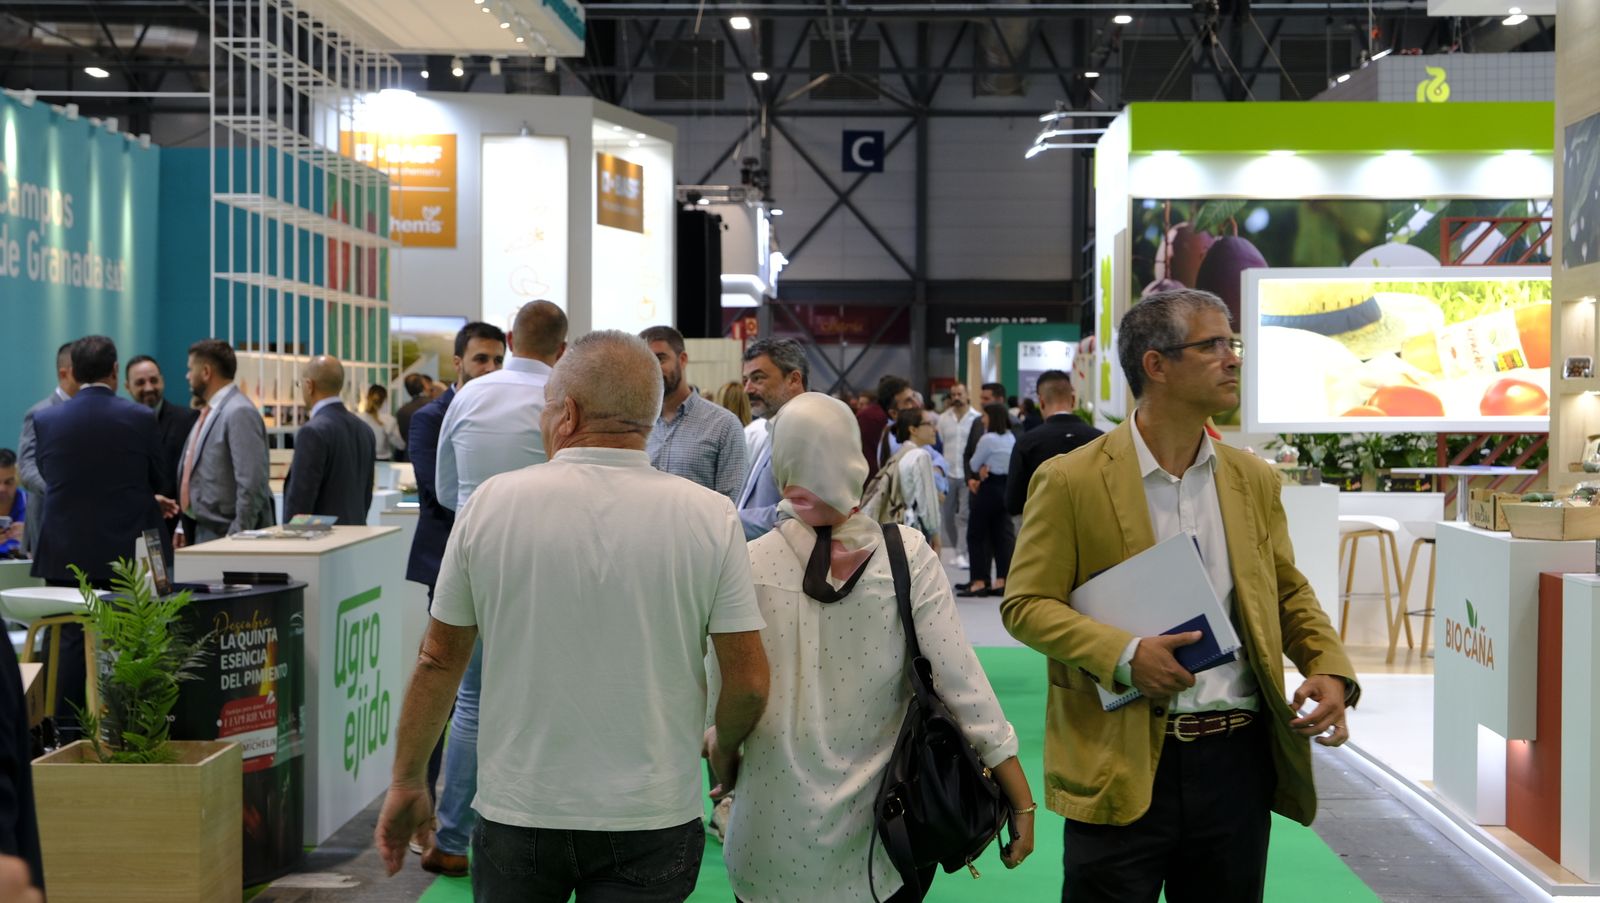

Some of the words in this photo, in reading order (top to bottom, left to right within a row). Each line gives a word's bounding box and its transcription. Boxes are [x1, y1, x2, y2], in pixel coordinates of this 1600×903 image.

[852, 136, 875, 167] C
[389, 215, 443, 234] hems
[0, 222, 20, 278] de
[26, 230, 104, 289] Granada
[213, 609, 271, 640] Descubre
[220, 633, 236, 650] LA
[237, 627, 279, 650] QUINTA
[220, 648, 269, 670] ESENCIA
[220, 672, 242, 690] DEL
[243, 662, 288, 686] PIMIENTO
[344, 669, 391, 782] ejido
